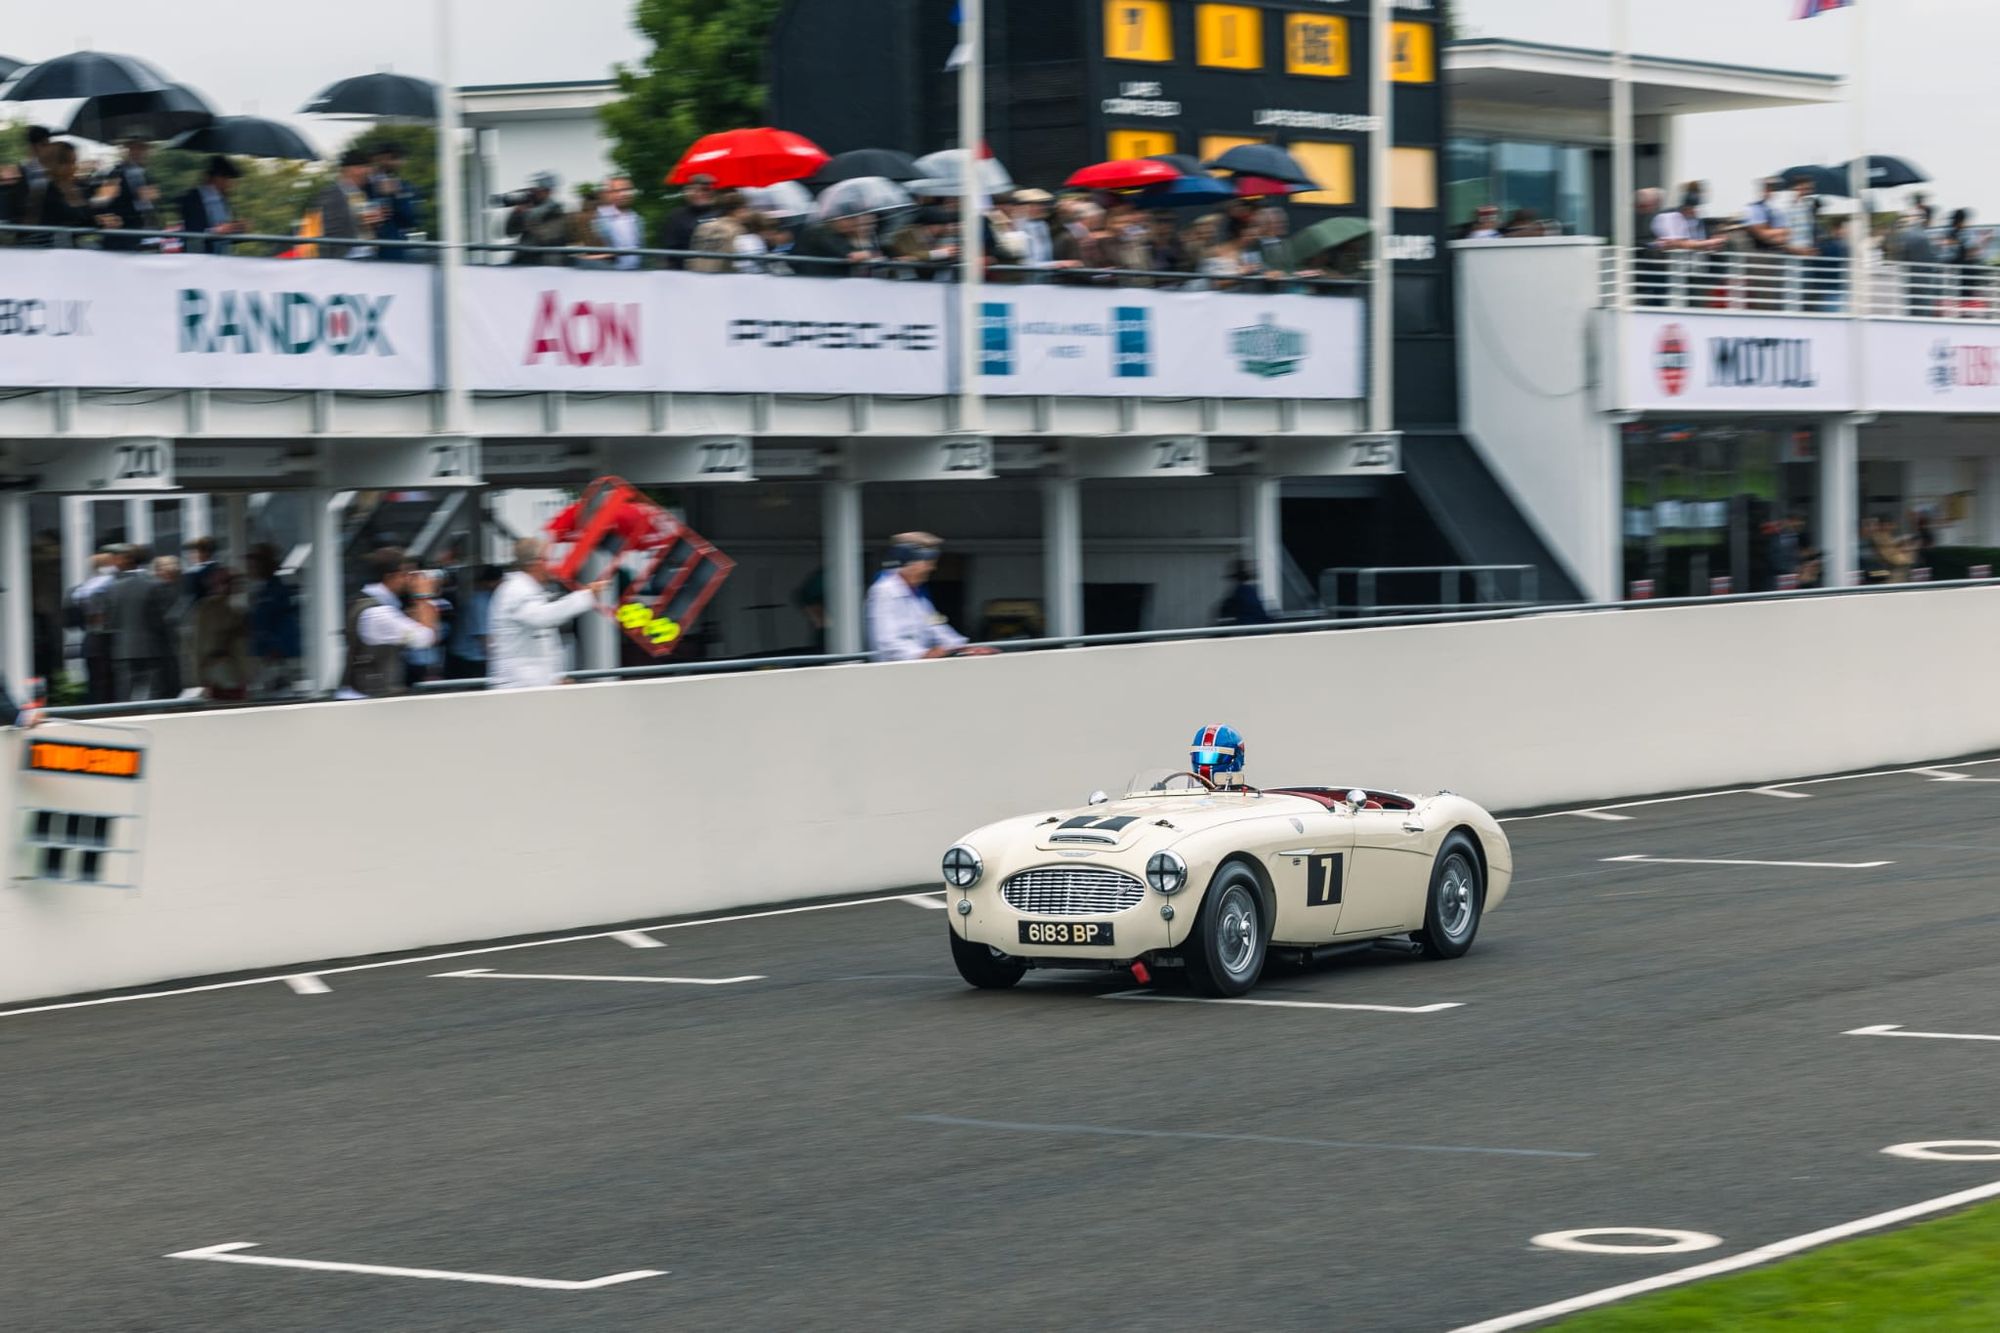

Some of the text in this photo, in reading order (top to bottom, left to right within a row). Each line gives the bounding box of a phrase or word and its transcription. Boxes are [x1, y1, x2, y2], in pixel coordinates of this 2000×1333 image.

[177, 288, 399, 357] RANDOX
[728, 319, 938, 351] PORSCHE
[1706, 336, 1817, 387] MOTUL
[1028, 923, 1099, 943] 6183 BP
